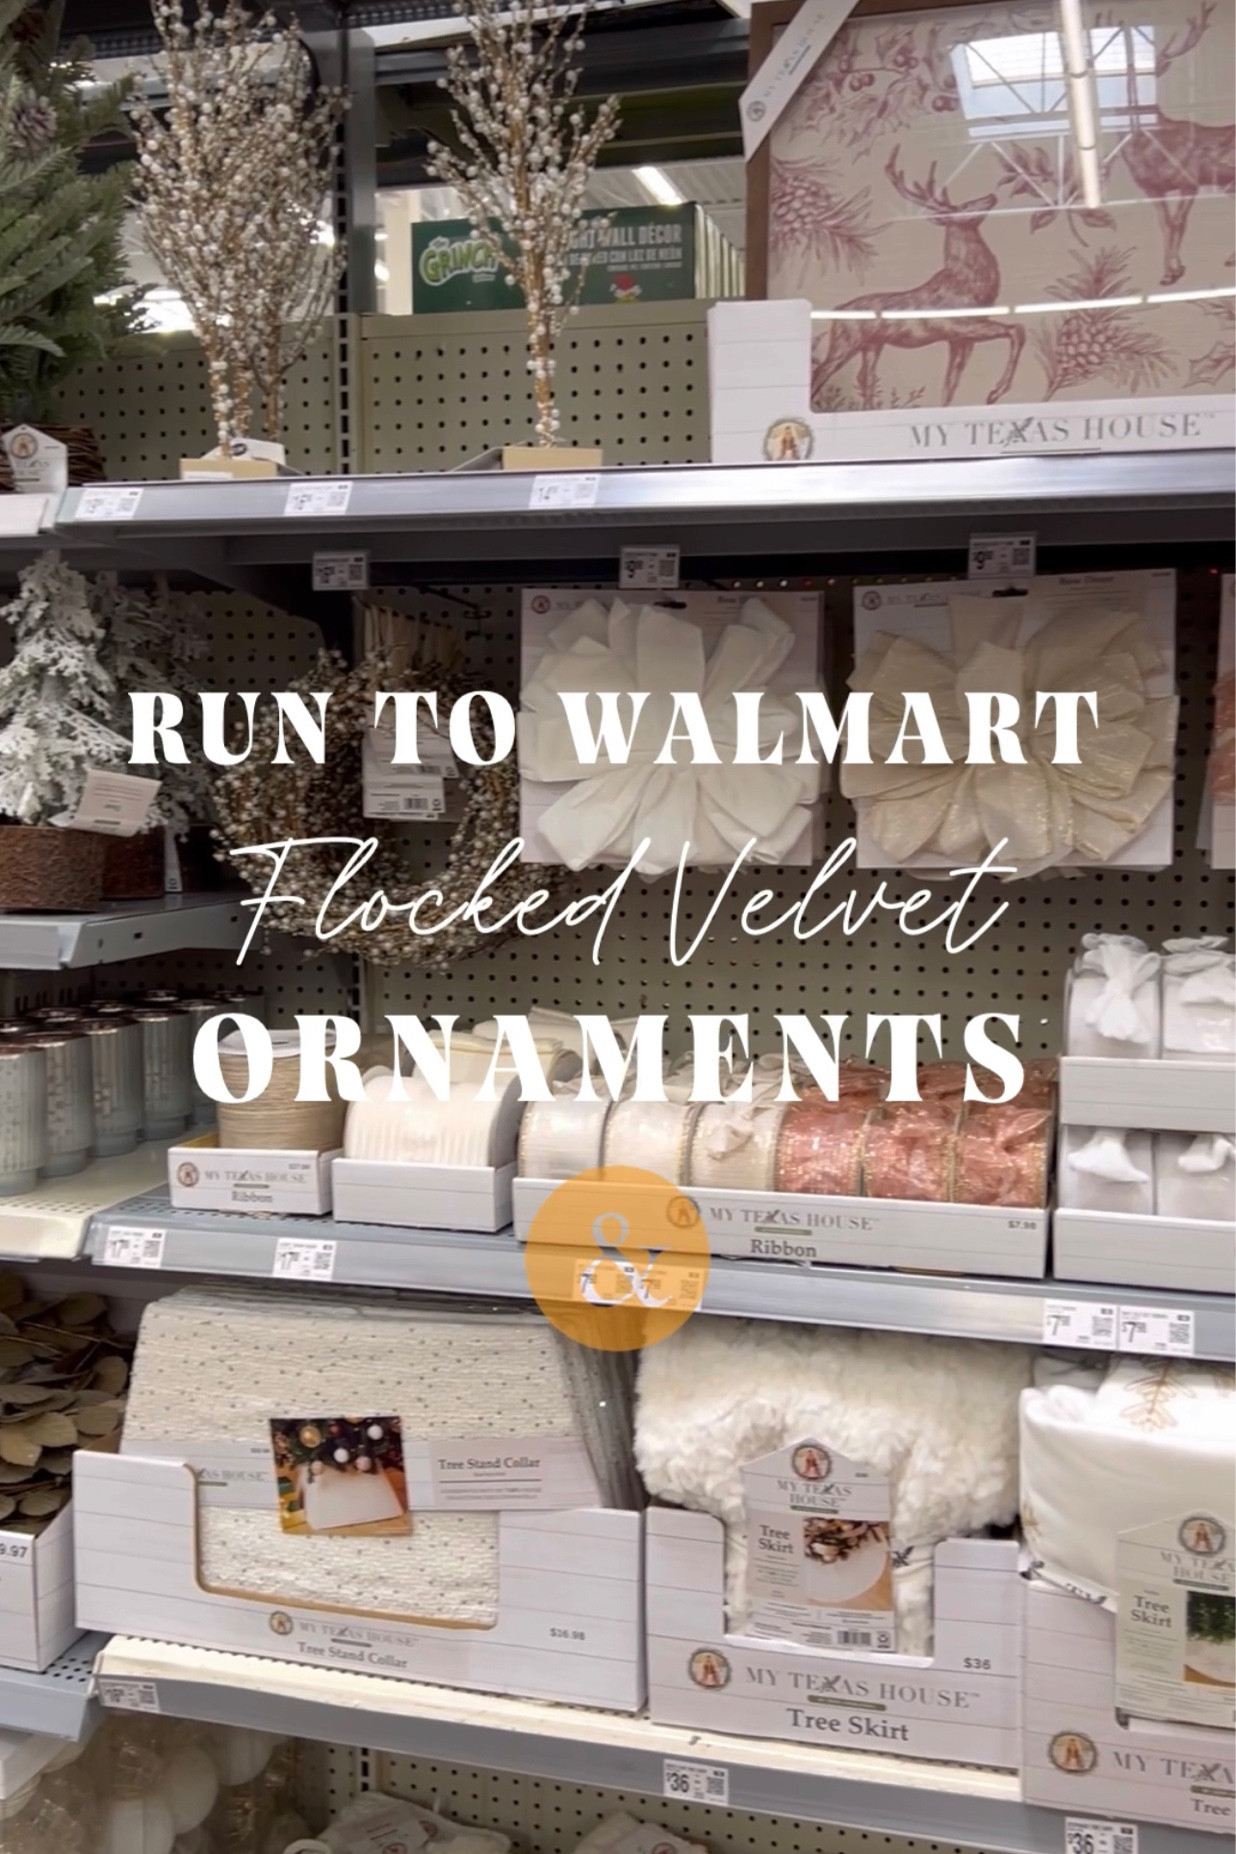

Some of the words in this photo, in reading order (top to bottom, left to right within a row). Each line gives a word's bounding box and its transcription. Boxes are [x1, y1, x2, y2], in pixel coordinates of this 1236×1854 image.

[910, 424, 949, 448] MY
[963, 416, 1070, 448] TEXAS
[231, 1191, 273, 1203] Ribbon
[710, 1207, 734, 1222] MY
[741, 1209, 801, 1226] TEXAS
[750, 1238, 818, 1259] Ribbon
[438, 1459, 464, 1470] Tree
[466, 1458, 500, 1470] Stand
[503, 1456, 541, 1469] Collar
[777, 1480, 797, 1492] MY
[803, 1483, 852, 1497] TEXAS
[759, 1524, 791, 1540] Tree
[758, 1538, 794, 1555] Skirt
[1160, 1551, 1184, 1564] MY
[1133, 1595, 1170, 1613] Tree
[299, 1622, 317, 1634] MY
[1131, 1610, 1172, 1628] Skirt
[297, 1641, 326, 1657] Tree
[328, 1645, 364, 1662] Stand
[367, 1652, 408, 1668] Collar
[963, 1656, 991, 1670] $36
[745, 1666, 781, 1686] MY
[787, 1671, 870, 1697] TEXAS
[786, 1707, 842, 1733] Tree
[848, 1715, 909, 1742] Skirt
[1113, 1751, 1147, 1772] MY
[1190, 1798, 1232, 1817] Tree
